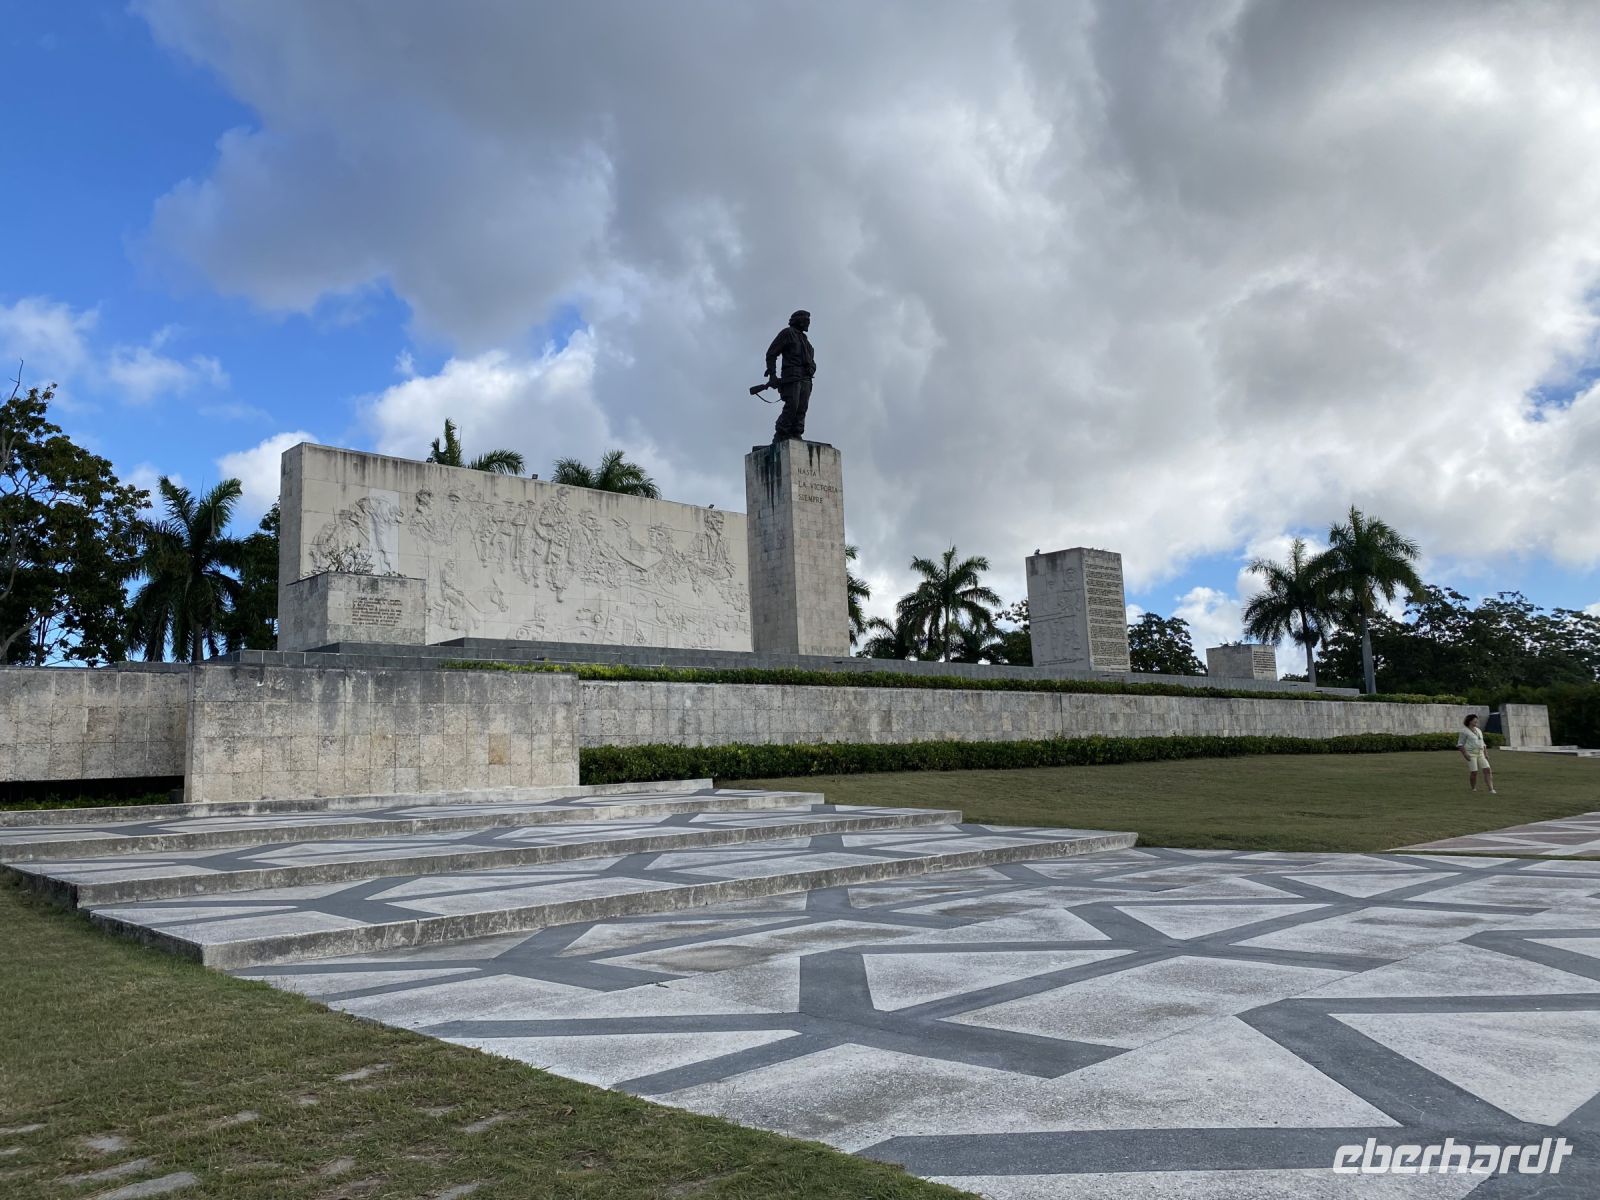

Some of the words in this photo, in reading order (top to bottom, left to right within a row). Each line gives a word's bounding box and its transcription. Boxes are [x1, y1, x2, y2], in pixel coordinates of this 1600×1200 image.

[797, 467, 817, 477] HASTA
[798, 480, 806, 488] LA
[810, 482, 838, 493] VICTORIA
[798, 494, 823, 504] SIEMPRE
